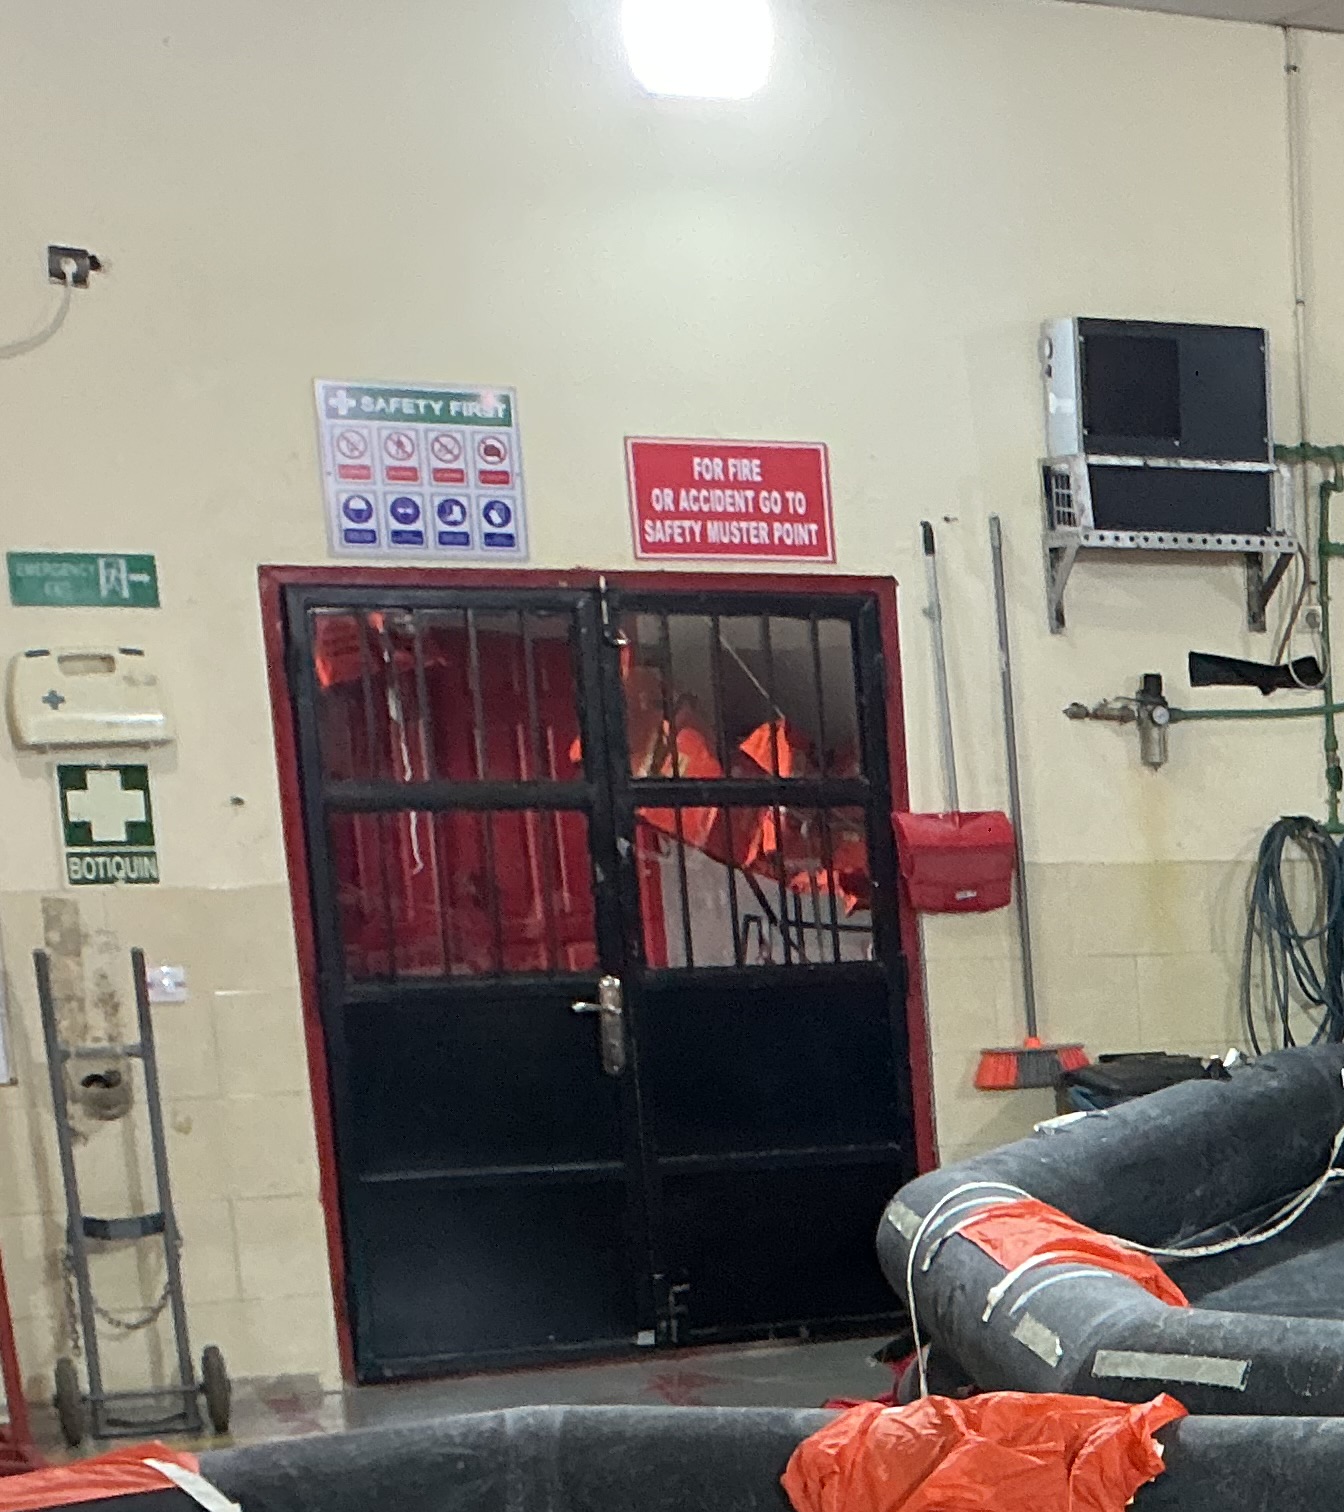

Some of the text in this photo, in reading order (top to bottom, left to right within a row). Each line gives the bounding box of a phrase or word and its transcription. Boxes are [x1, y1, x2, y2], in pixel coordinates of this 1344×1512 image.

[360, 395, 507, 418] SAFETY FIRST
[693, 457, 763, 482] FOR FIRE
[651, 488, 807, 515] OR ACCIDENT GO TO
[644, 519, 818, 546] SAFETY MUSTER POINT
[68, 856, 158, 882] BOTIQUIN
